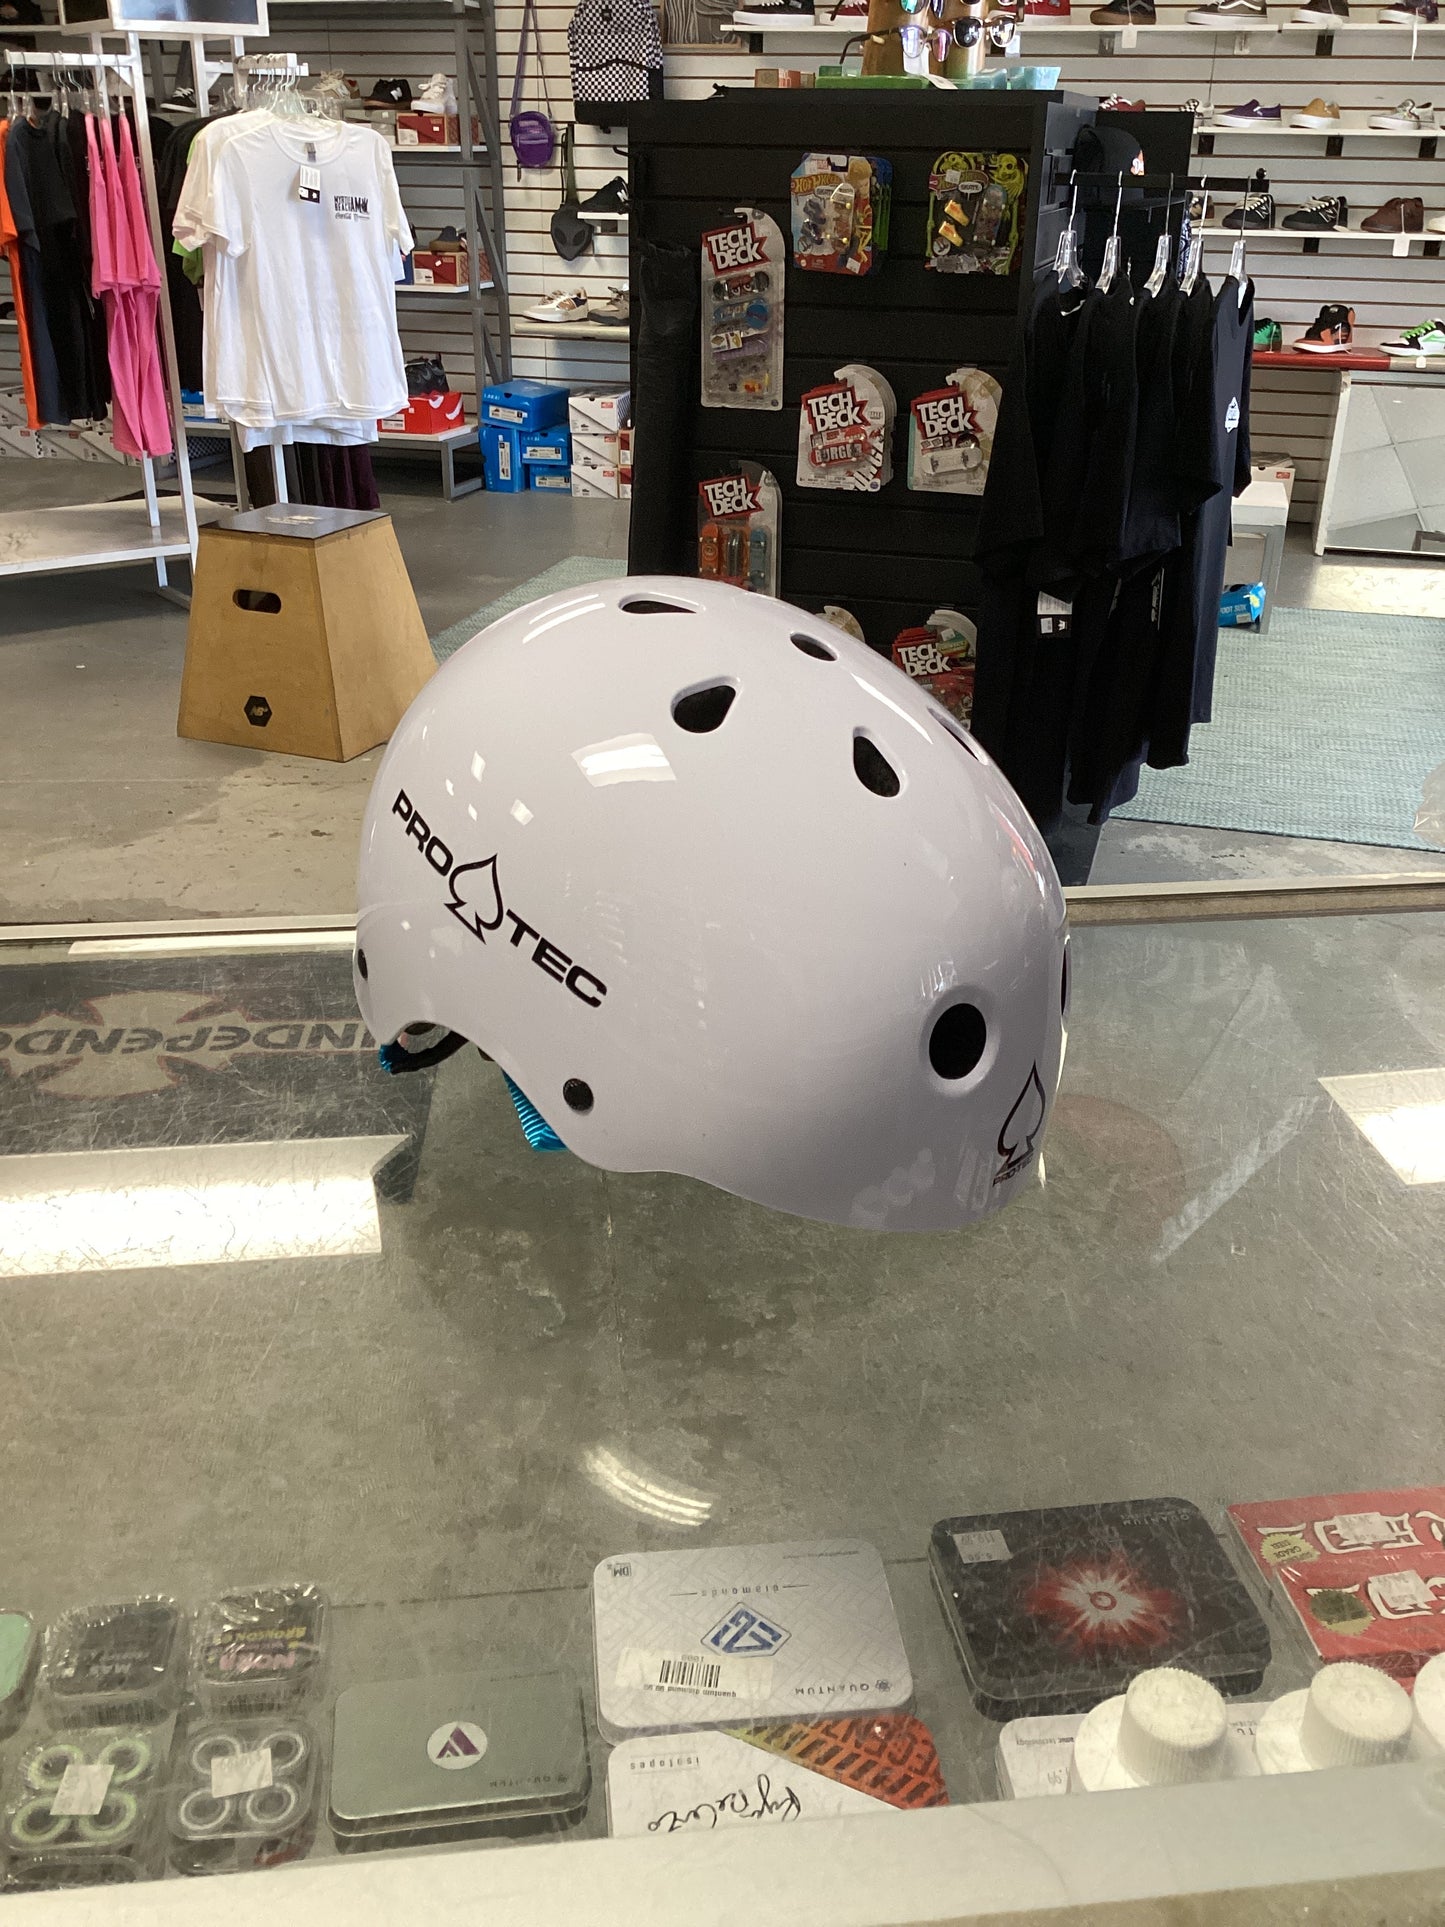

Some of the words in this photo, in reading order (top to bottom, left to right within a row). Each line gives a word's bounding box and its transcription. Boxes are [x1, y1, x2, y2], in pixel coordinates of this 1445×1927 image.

[707, 227, 753, 252] TECH
[716, 243, 763, 270] DECK
[808, 391, 853, 418] TECH
[917, 397, 965, 424] TECH
[815, 406, 862, 433] DECK
[924, 412, 974, 438] DECK
[704, 478, 748, 503] TECH
[712, 492, 757, 517] DECK
[898, 643, 943, 664] TECH
[905, 654, 952, 677] DECK
[392, 788, 454, 877] PRO
[506, 908, 608, 1008] TEC
[701, 1584, 779, 1597] diamonds
[795, 1684, 870, 1696] QUANTUM
[629, 1756, 699, 1771] isotopes
